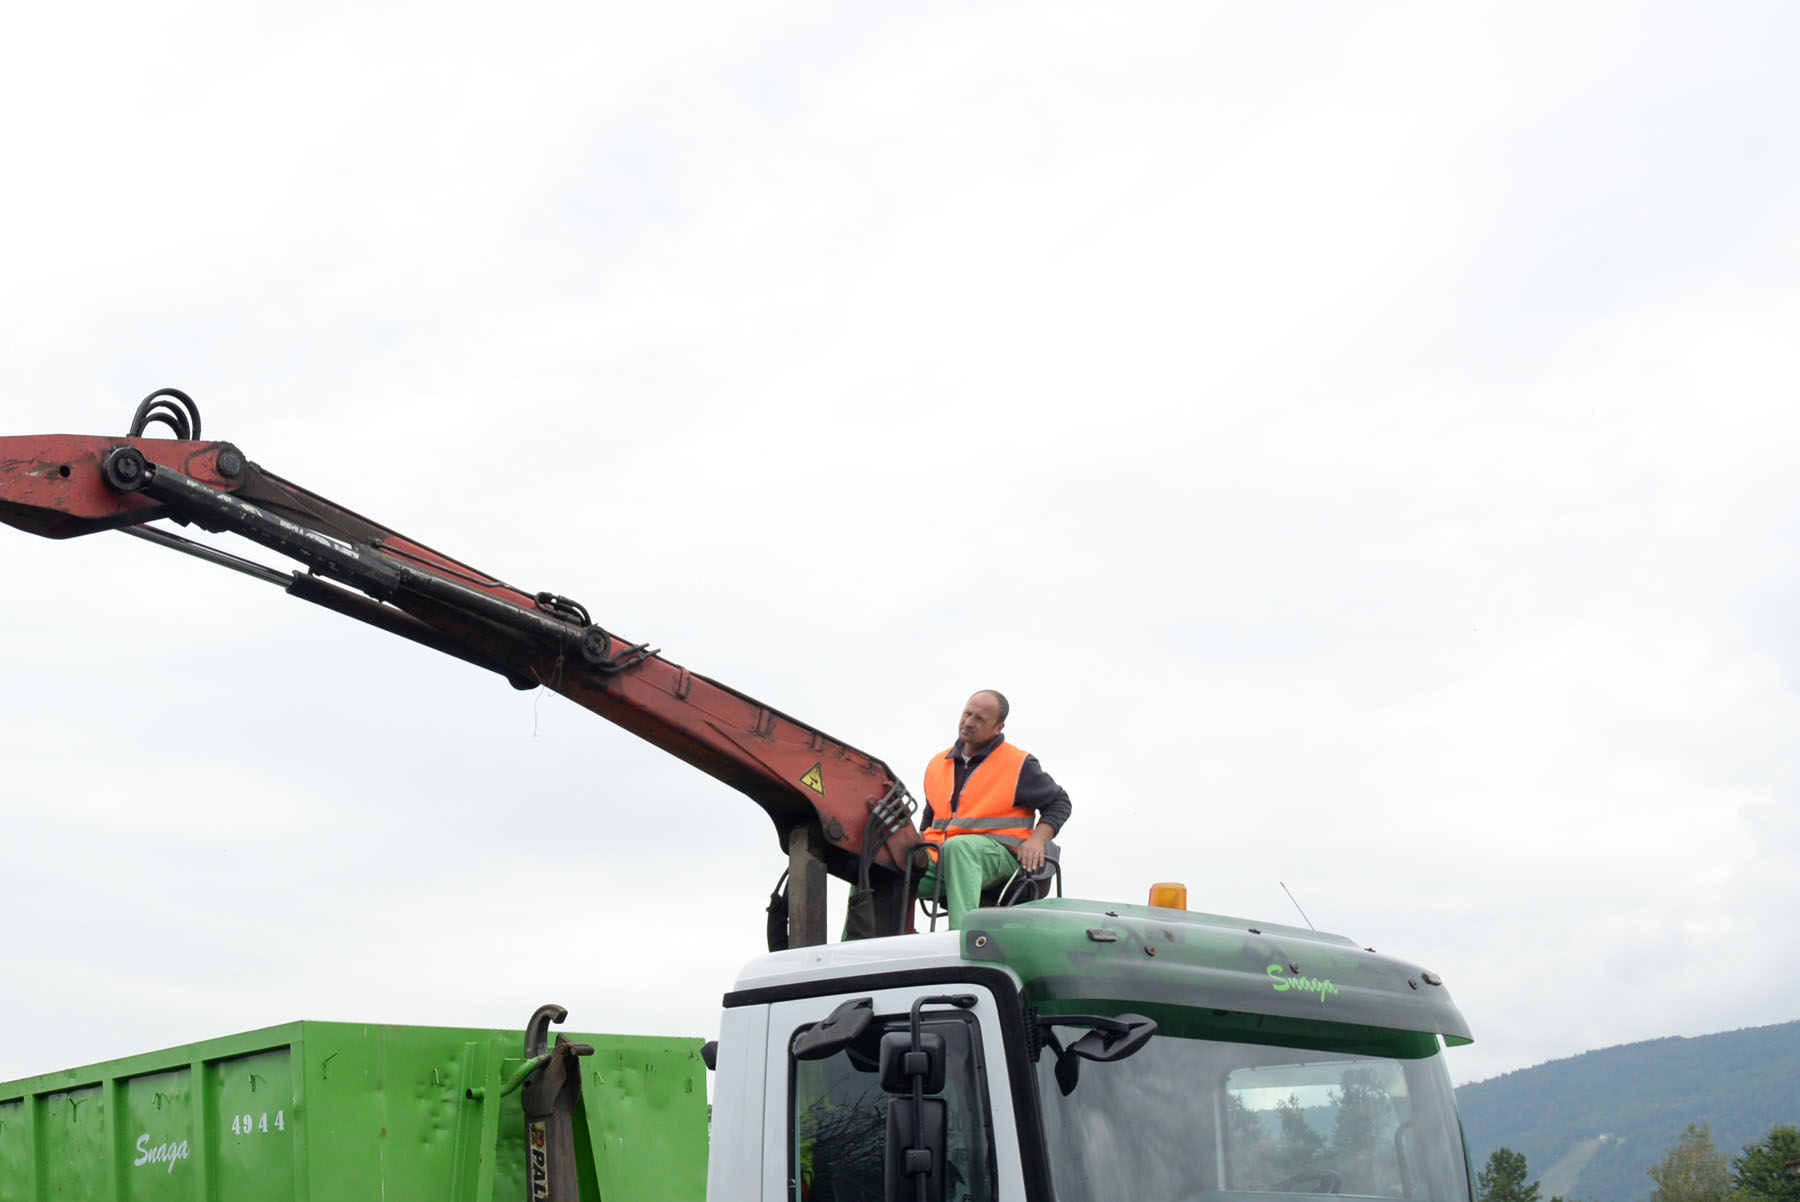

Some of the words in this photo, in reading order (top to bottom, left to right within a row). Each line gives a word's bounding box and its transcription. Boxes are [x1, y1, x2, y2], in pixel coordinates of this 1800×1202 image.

[1266, 964, 1338, 1003] Snaga
[232, 1110, 285, 1135] 4944
[134, 1133, 190, 1174] Snaga
